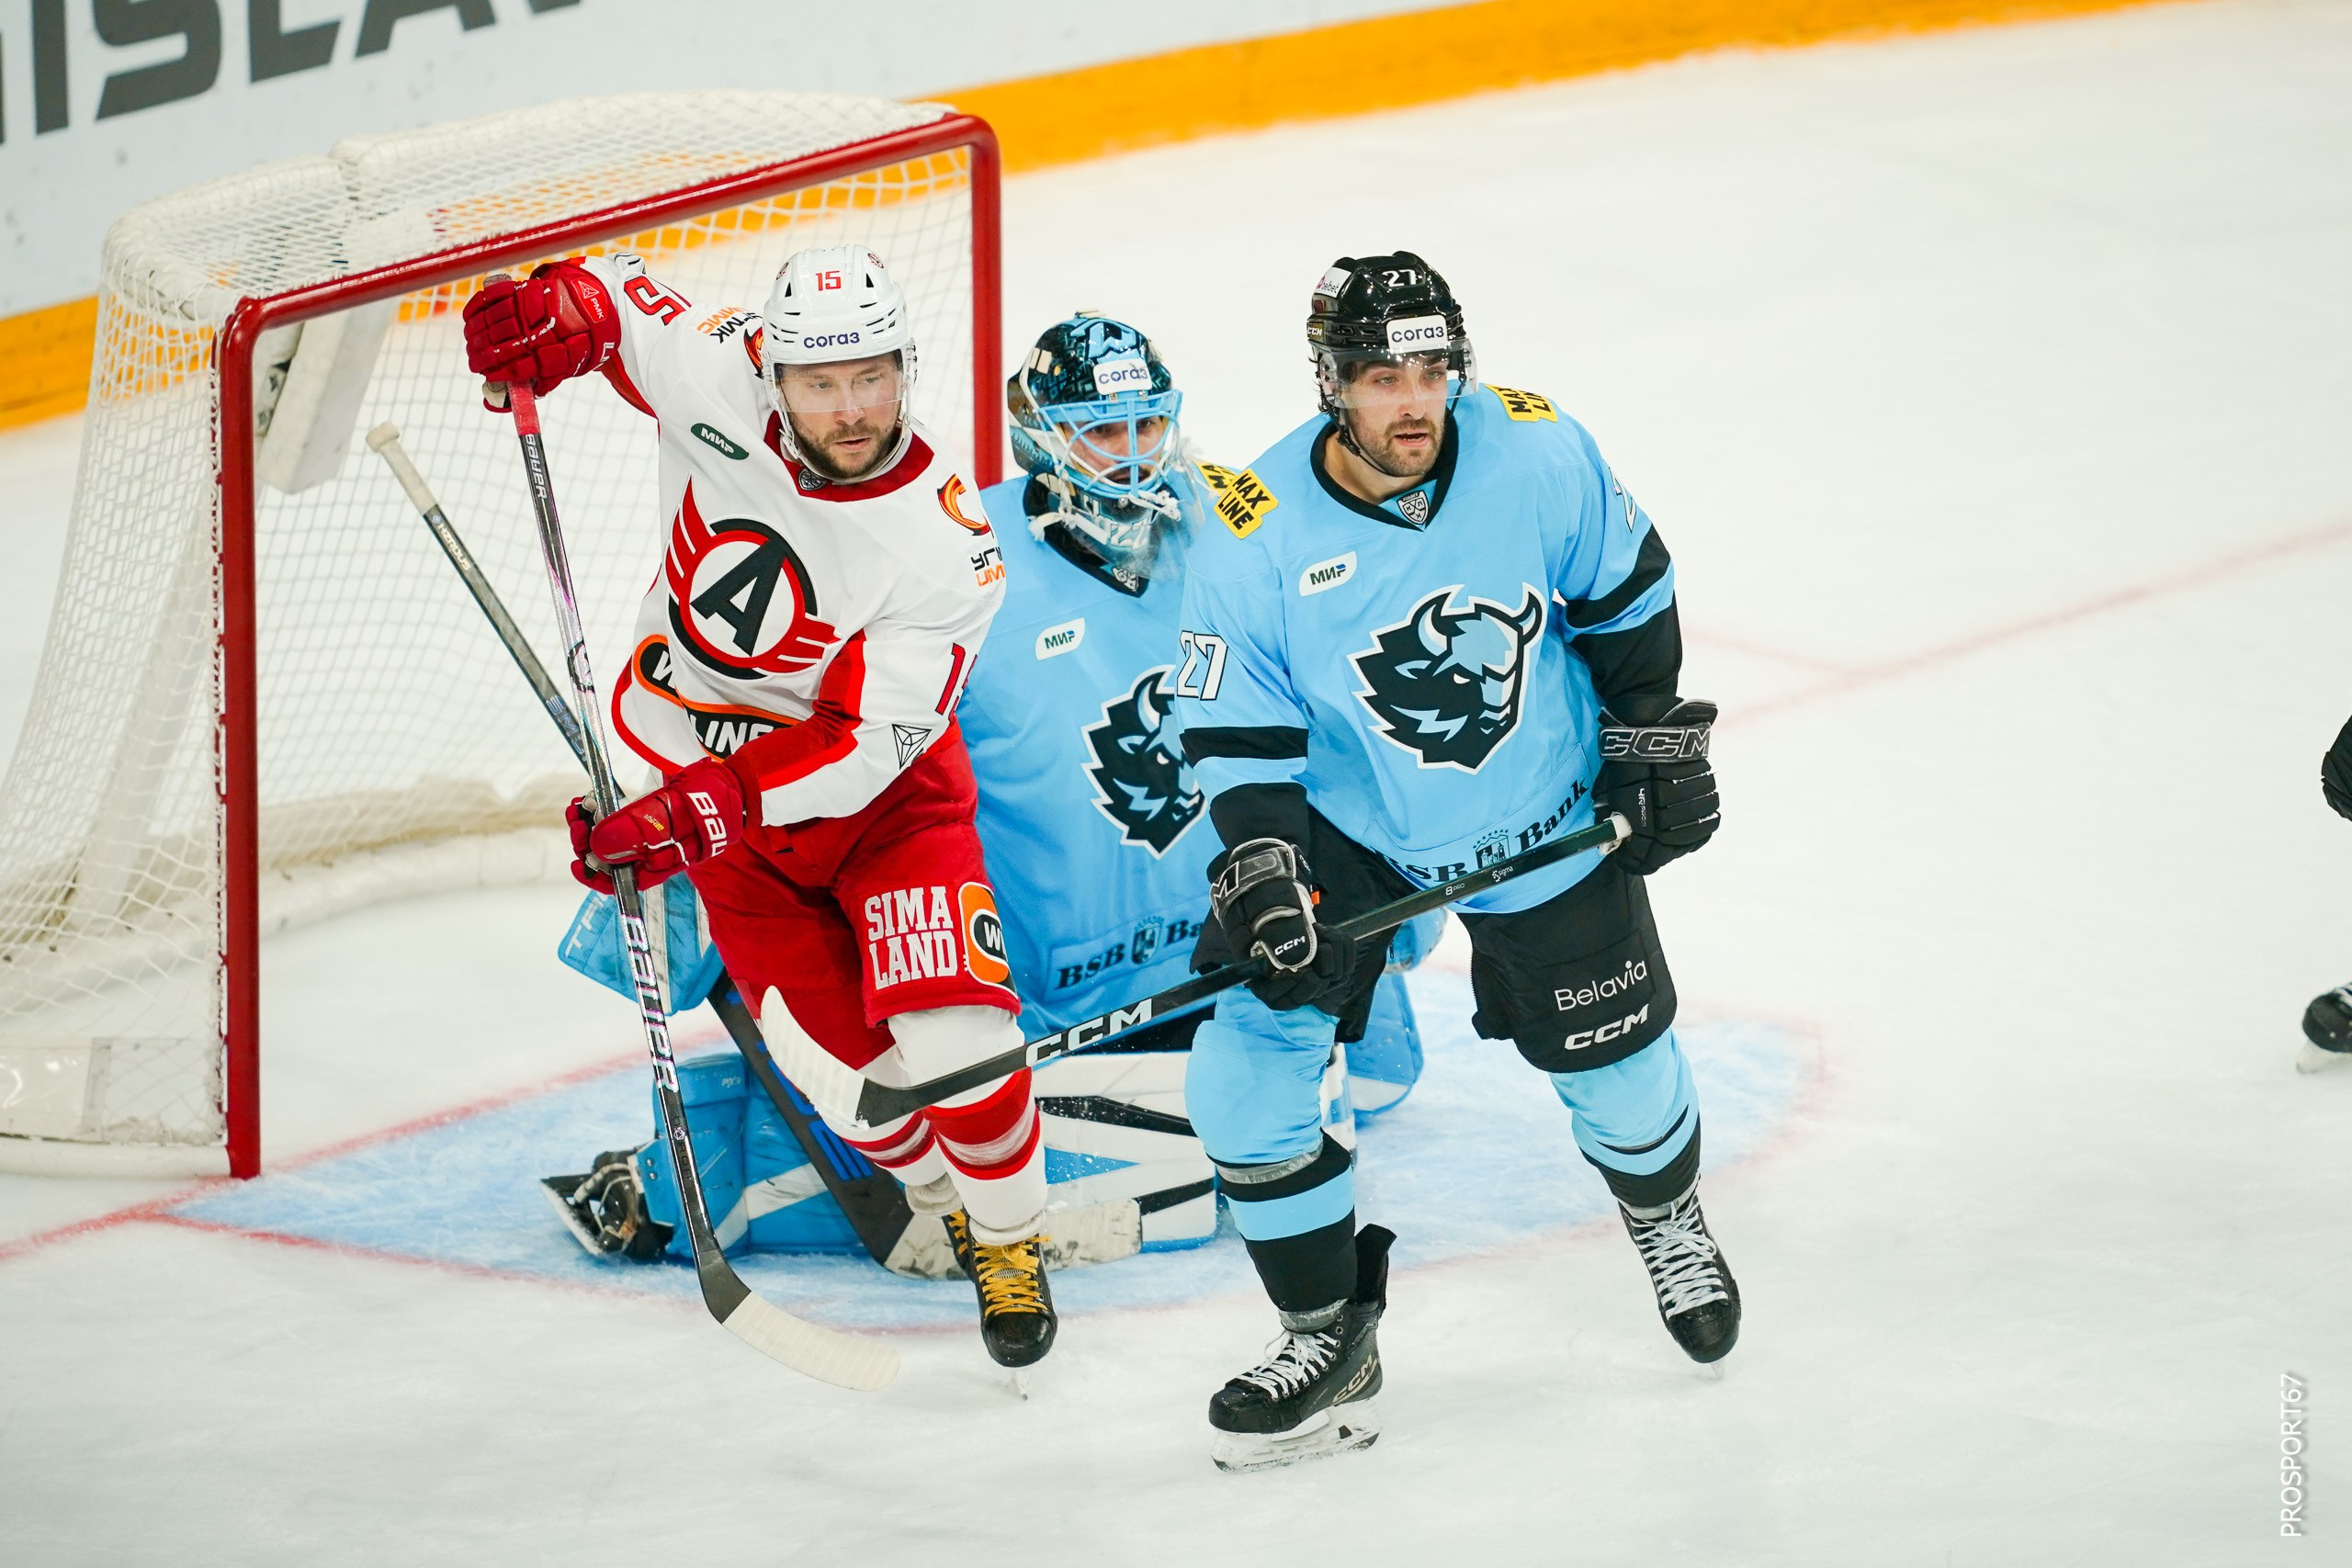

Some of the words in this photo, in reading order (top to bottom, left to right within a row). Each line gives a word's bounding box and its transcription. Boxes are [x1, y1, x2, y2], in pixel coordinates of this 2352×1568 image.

[816, 270, 842, 291] 15
[1382, 269, 1418, 288] 27
[803, 332, 860, 349] согаз
[1391, 325, 1444, 344] согаз
[1098, 367, 1148, 385] согаз
[701, 427, 737, 456] МИР
[1218, 491, 1255, 530] LINE
[1232, 473, 1271, 510] MAX
[436, 523, 471, 571] HZRDUS
[1308, 564, 1347, 586] МИР
[1045, 630, 1076, 649] МИР
[1176, 630, 1227, 701] 27
[1599, 728, 1711, 758] CCM
[1389, 858, 1468, 883] SB
[1515, 777, 1589, 854] Bank
[865, 886, 955, 942] SIMA
[868, 931, 958, 990] LAND
[1056, 942, 1125, 989] BSB
[1164, 919, 1203, 947] Ba
[1274, 936, 1306, 955] CCM
[1555, 960, 1647, 1011] Belavia
[1025, 998, 1152, 1067] CCM
[1564, 1003, 1649, 1050] CCM
[1332, 1352, 1374, 1404] CCM
